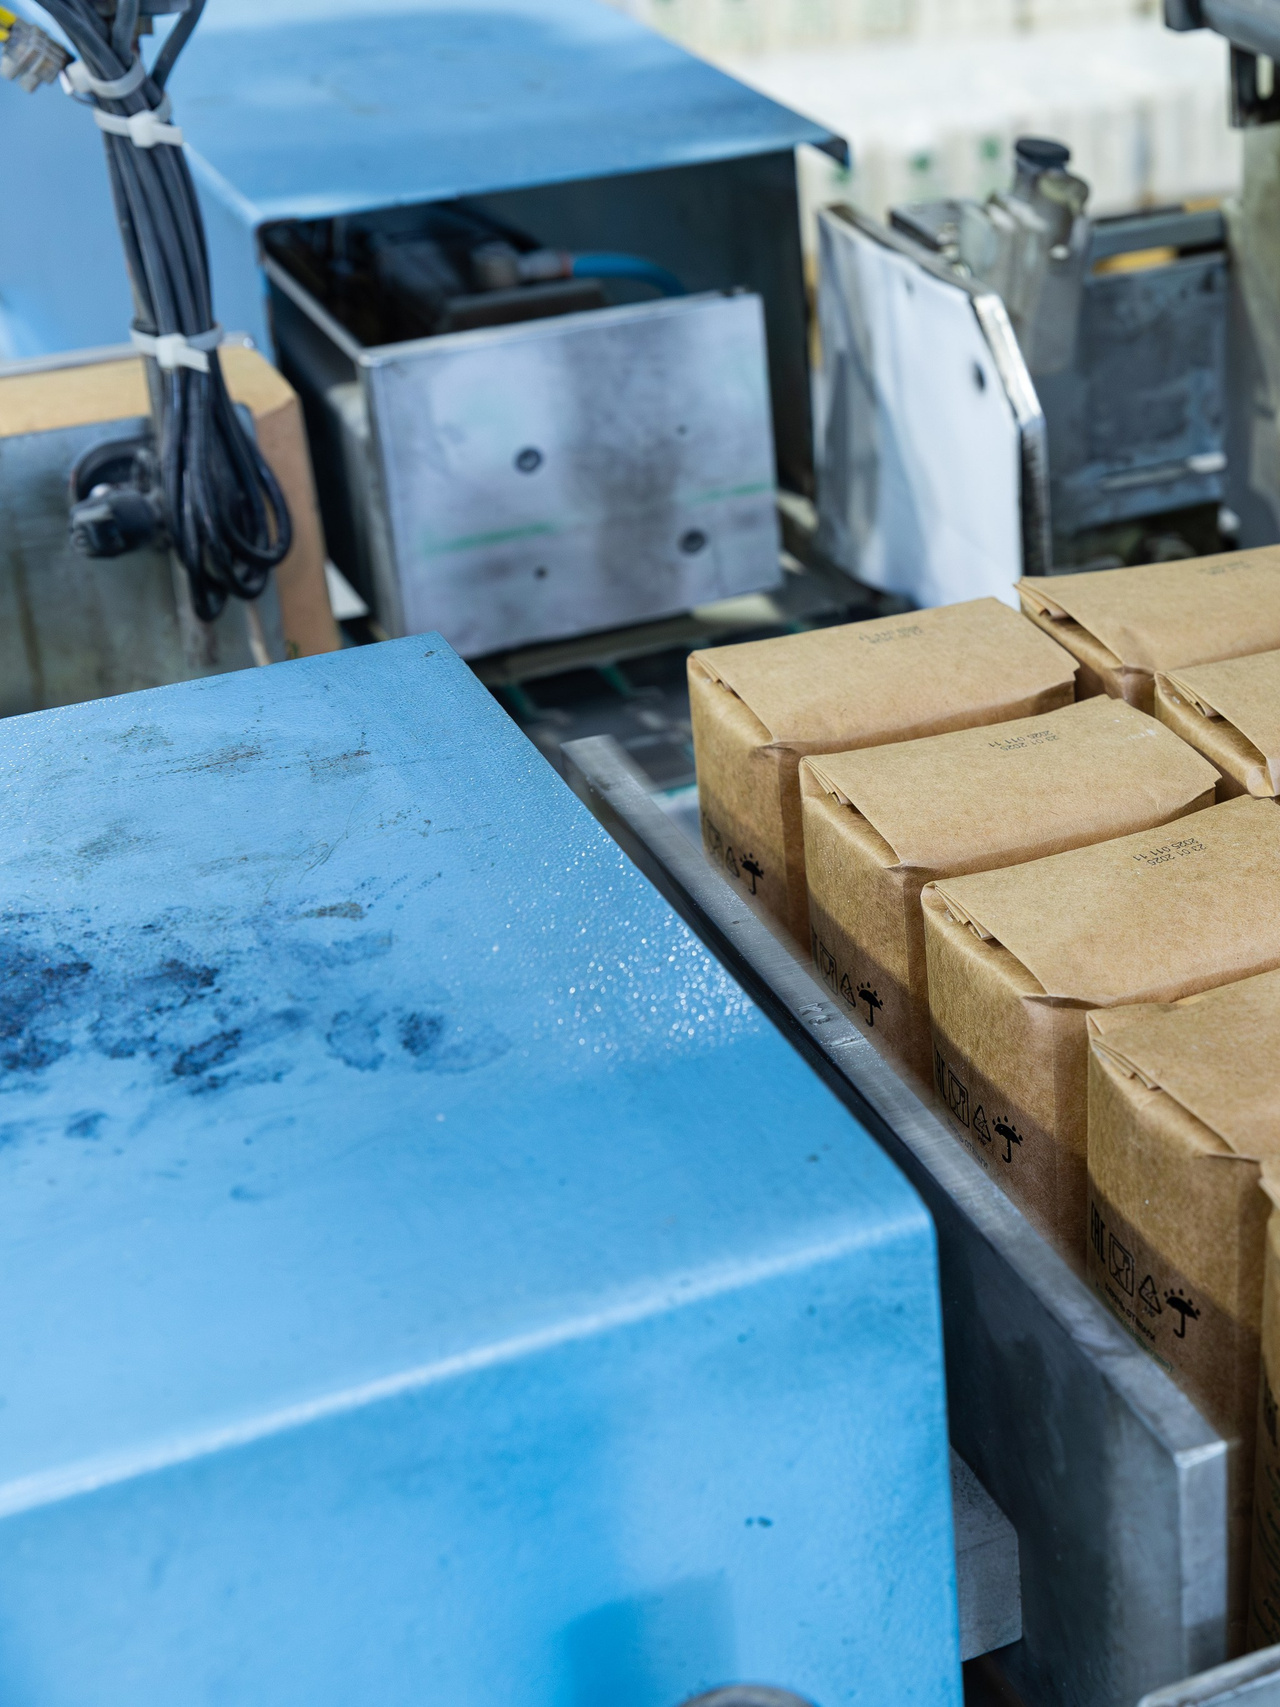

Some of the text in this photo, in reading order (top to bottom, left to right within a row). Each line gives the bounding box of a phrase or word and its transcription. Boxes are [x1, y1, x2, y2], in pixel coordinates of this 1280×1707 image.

[1132, 837, 1199, 861] 2025 011 11
[1146, 843, 1207, 865] 23 01 2025
